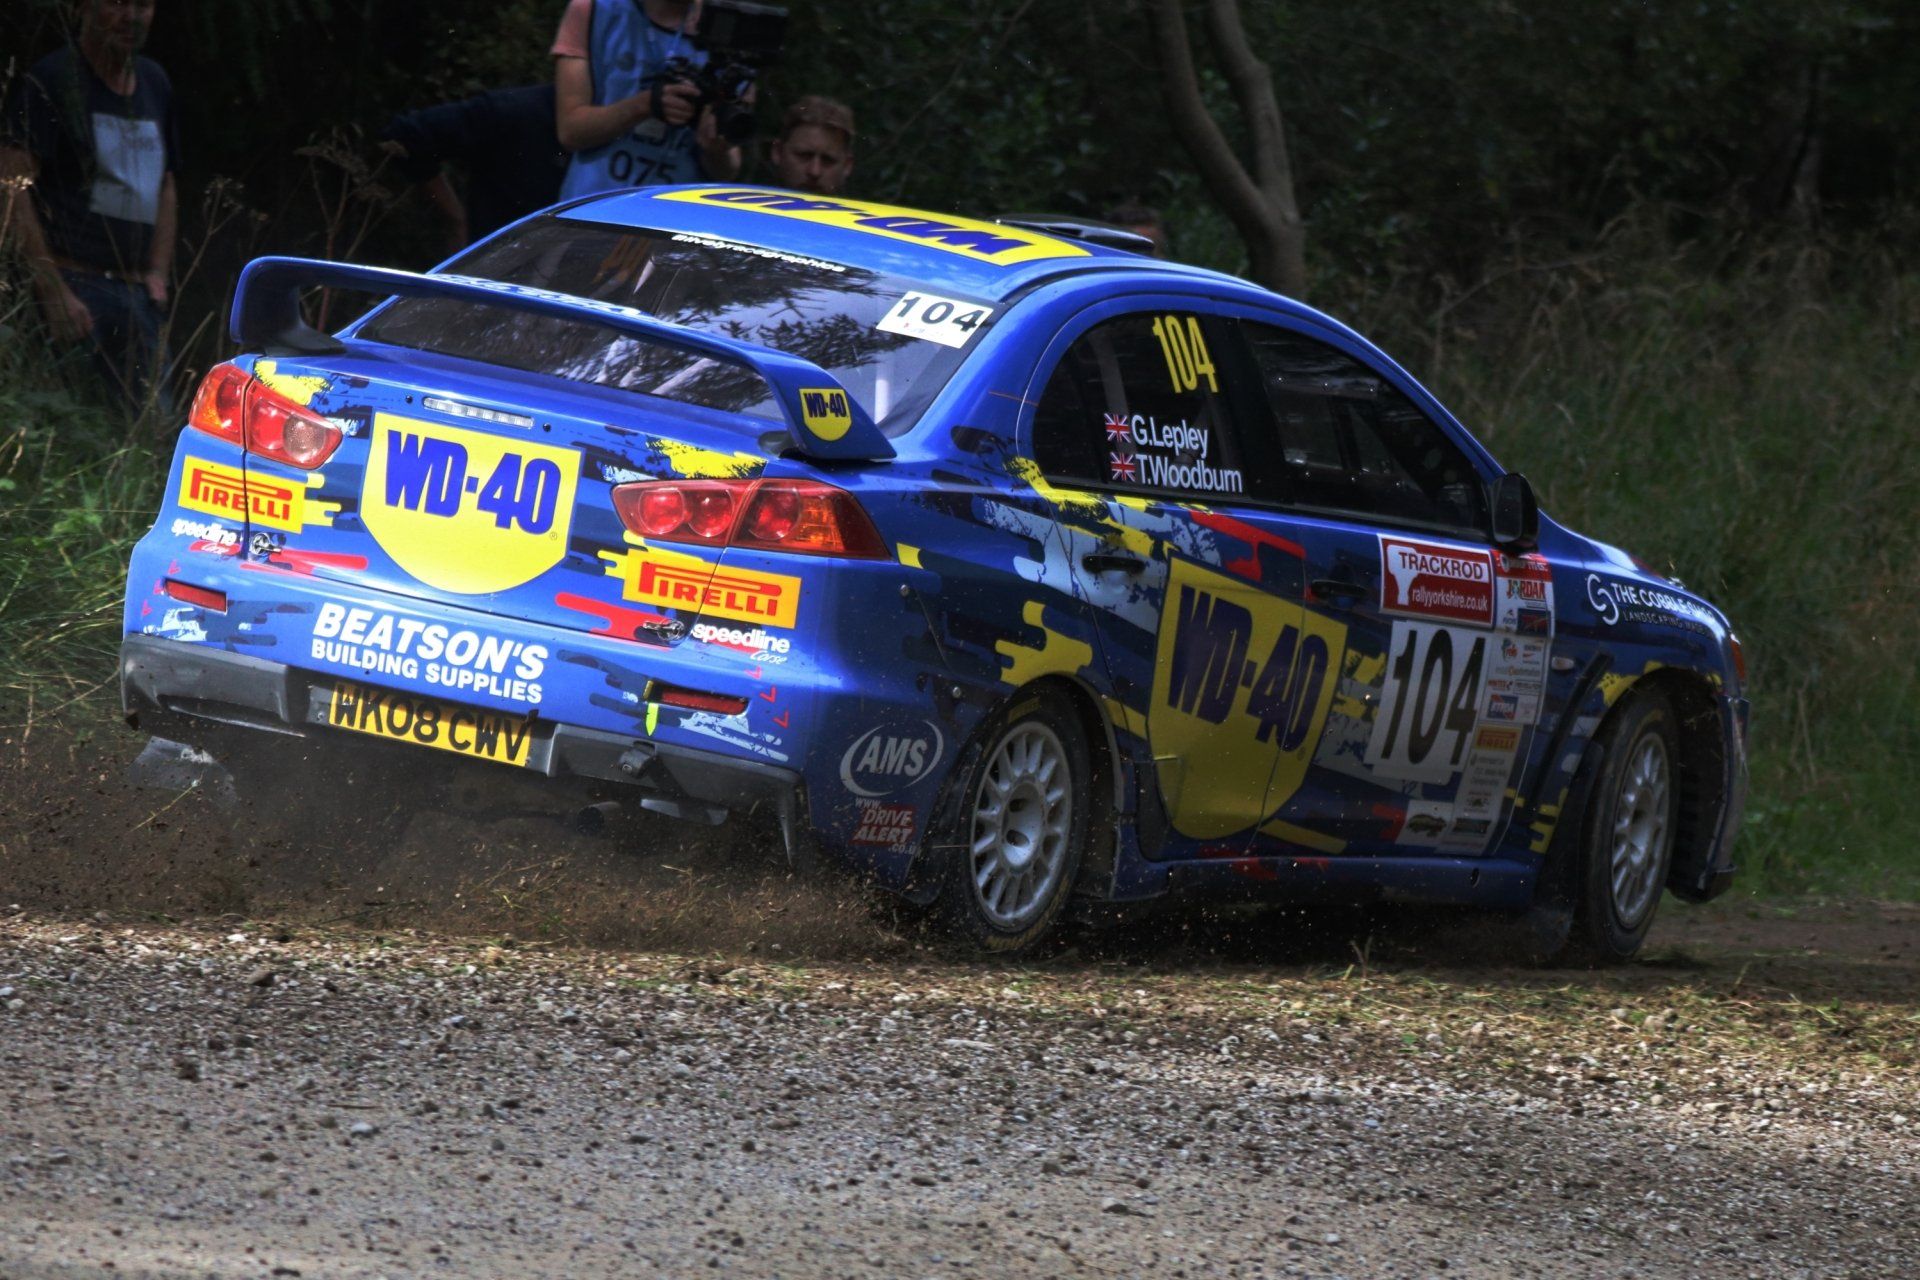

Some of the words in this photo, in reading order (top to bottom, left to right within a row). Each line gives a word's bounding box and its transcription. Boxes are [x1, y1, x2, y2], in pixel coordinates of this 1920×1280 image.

[897, 296, 985, 333] 104
[1152, 315, 1219, 394] 104
[803, 392, 847, 418] WD-40
[1131, 414, 1209, 459] G.Lepley
[190, 468, 293, 521] PIRELLI
[385, 429, 562, 536] WD-40
[1135, 454, 1243, 493] T.Woodburn
[171, 518, 237, 546] speedline
[1398, 552, 1483, 580] TRACKROD
[638, 561, 783, 617] PIRELLI
[1412, 586, 1488, 611] rallyyorkshire.co.uk
[1610, 582, 1641, 605] THE
[313, 602, 548, 680] BEATSON'S
[692, 623, 790, 654] speedline
[311, 638, 418, 680] BUILDING
[425, 663, 543, 704] SUPPLIES
[1167, 584, 1328, 752] WD-40
[1381, 629, 1486, 766] 104
[334, 682, 442, 743] WK08
[448, 708, 536, 762] CWV
[856, 735, 927, 777] AMS
[853, 825, 913, 842] ALERT
[863, 809, 913, 827] DRIVE
